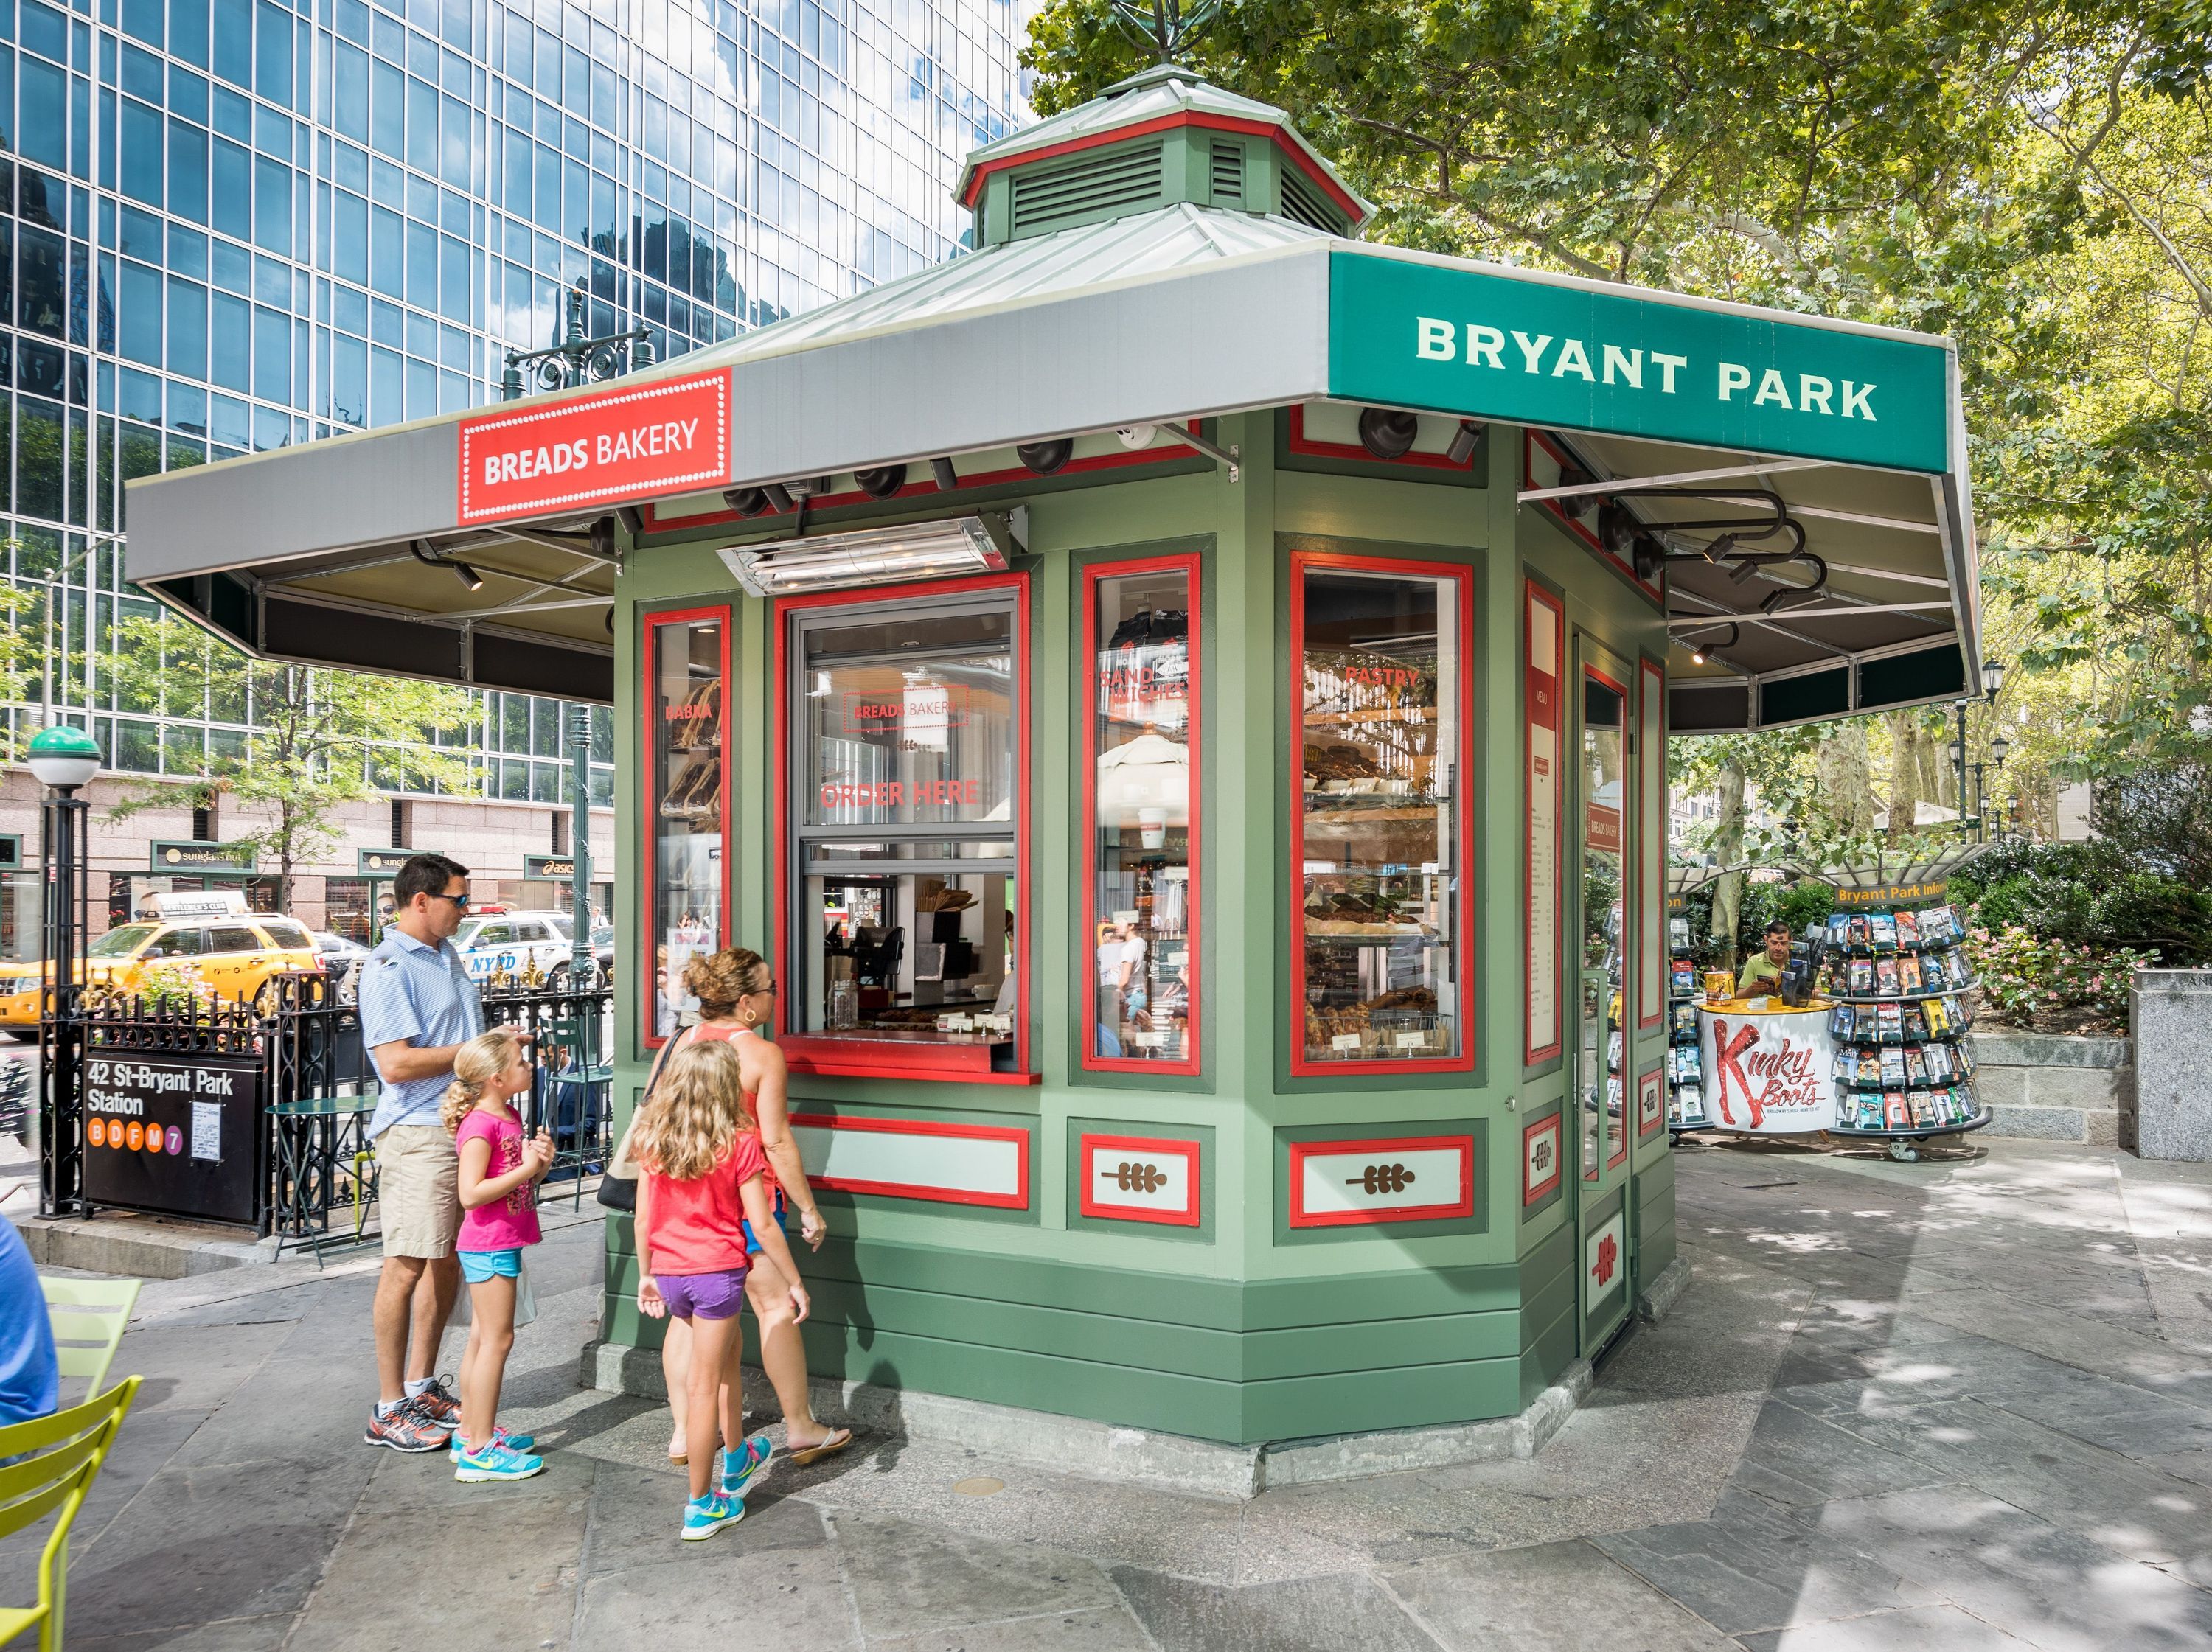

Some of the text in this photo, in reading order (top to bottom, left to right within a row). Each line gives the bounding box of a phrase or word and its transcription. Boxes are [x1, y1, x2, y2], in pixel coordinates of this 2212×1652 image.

[1416, 316, 1878, 421] BRYANT PARK
[484, 417, 699, 485] BREADS BAKERY
[1100, 666, 1153, 687] SAND
[1346, 666, 1419, 687] PASTRY
[1110, 683, 1186, 703] WICHES
[1536, 689, 1548, 705] MENU
[665, 703, 712, 720] BABKA
[854, 701, 957, 719] BREADS BAKERY
[821, 779, 979, 809] ORDER HERE
[1591, 820, 1605, 835] BREADS
[553, 863, 574, 874] asic
[1838, 888, 1886, 906] Bryant
[1891, 885, 1921, 899] Park
[88, 1062, 233, 1095] 42 St-Bryant Park
[1712, 1018, 1816, 1129] Kinky
[87, 1088, 143, 1115] Station
[1759, 1077, 1827, 1106] Boots
[92, 1125, 178, 1149] B D F M 7
